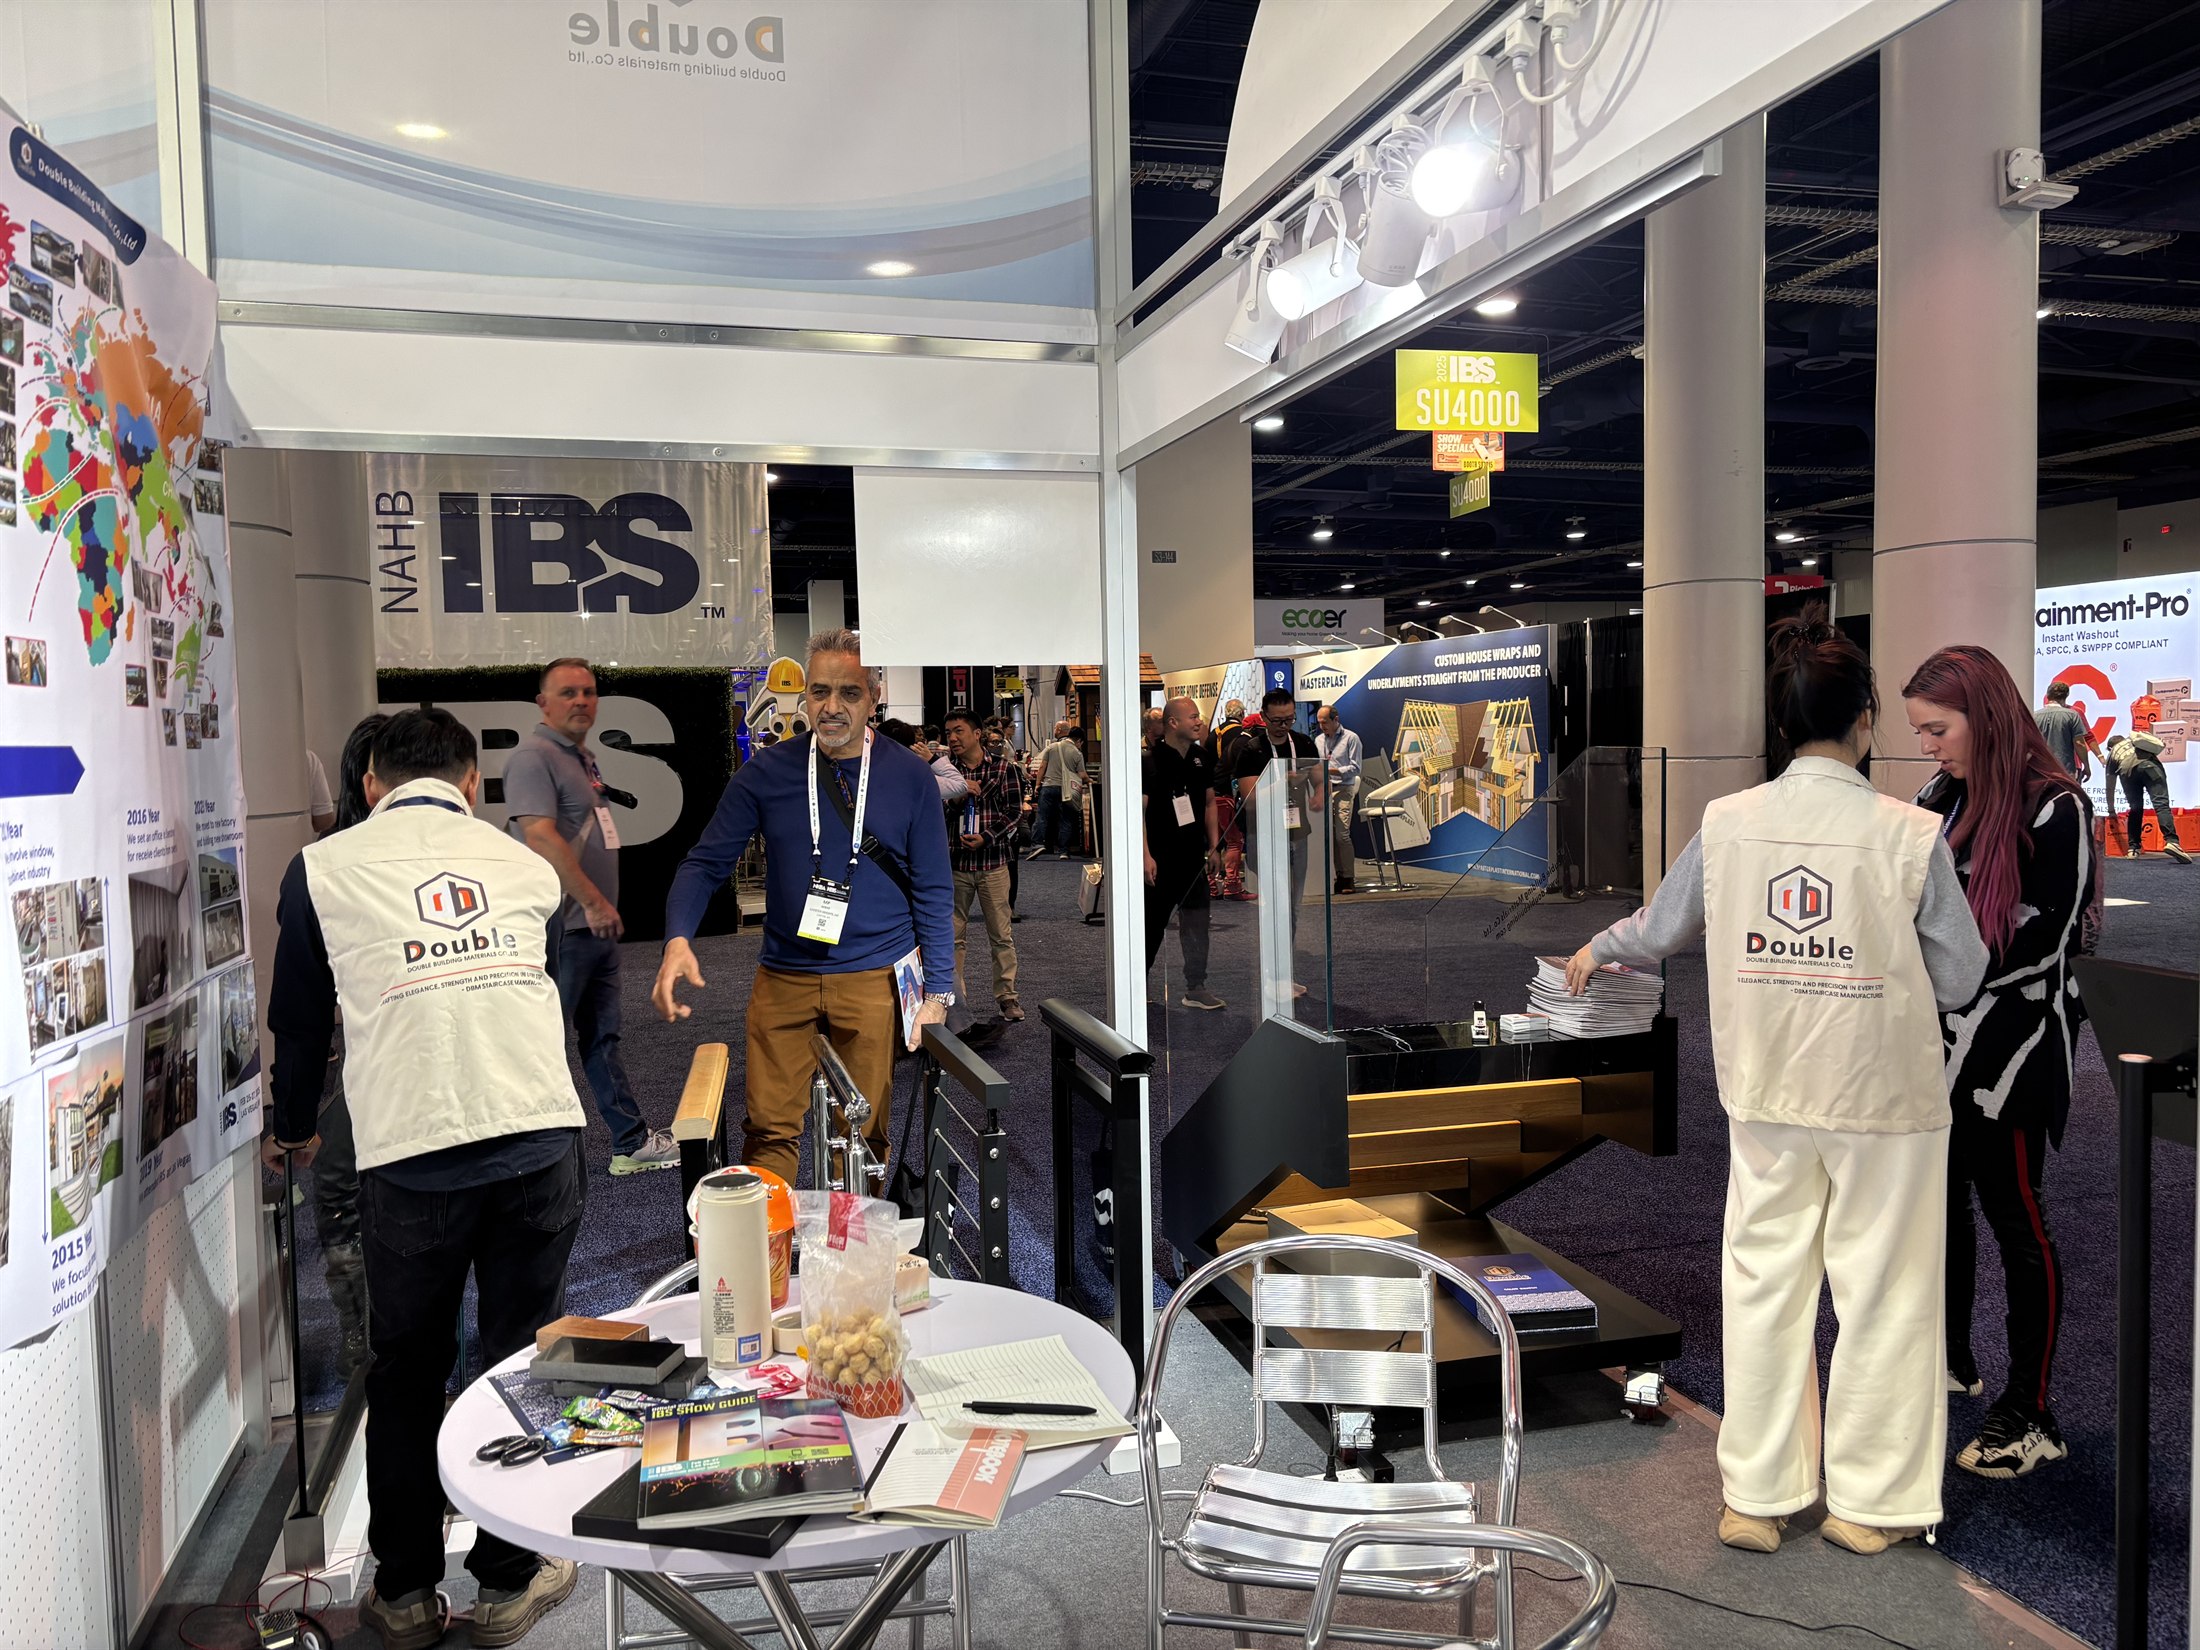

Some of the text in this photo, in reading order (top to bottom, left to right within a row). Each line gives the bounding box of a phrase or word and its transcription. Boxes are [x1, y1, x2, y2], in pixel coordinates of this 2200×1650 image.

[38, 157, 68, 189] Double
[1437, 355, 1446, 382] 2025
[1450, 356, 1496, 384] IBS
[1416, 388, 1520, 427] SU4000
[1437, 434, 1463, 444] SHOW
[1437, 444, 1475, 453] SPECIALS
[1452, 475, 1486, 508] SU4000
[375, 490, 419, 613] NAHB
[439, 491, 700, 615] IBS
[1282, 608, 1347, 628] ecoer
[2042, 629, 2119, 643] Instant Washout
[2046, 645, 2072, 656] SPCC,
[2073, 644, 2080, 653] &
[2081, 642, 2113, 653] SWPPP
[2114, 638, 2169, 651] COMPLIANT
[1434, 644, 1542, 668] CUSTOM HOUSE WRAPS AND
[1300, 675, 1348, 691] MASTERPLAST
[1367, 664, 1542, 691] UNDERLAYMENTS STRAIGHT FROM THE PRODUCER
[127, 808, 161, 826] 2016 Year
[127, 834, 136, 845] We
[137, 833, 146, 844] set
[127, 851, 135, 862] for
[136, 849, 153, 861] receive
[403, 927, 517, 965] Double
[1746, 932, 1854, 960] Double
[407, 962, 432, 974] DOUBLE
[433, 956, 463, 968] BUILDING
[464, 951, 497, 963] MATERIALS
[1746, 956, 1769, 964] DOUBLE
[1769, 957, 1797, 965] BUILDING
[1798, 960, 1830, 968] MATERIALS
[405, 983, 441, 998] ELEGANCE,
[441, 977, 473, 990] STRENGTH
[473, 974, 489, 983] AND
[465, 984, 482, 992] DBM
[482, 978, 517, 990] STAIRCASE
[1741, 977, 1772, 985] ELEGANCE,
[1773, 979, 1802, 987] STRENGTH
[1817, 982, 1848, 991] PRECISION
[1808, 989, 1839, 998] STAIRCASE
[52, 1236, 83, 1271] 2015
[51, 1276, 66, 1295] We
[52, 1289, 88, 1317] solution
[651, 1394, 757, 1420] IBS SHOW GUIDE
